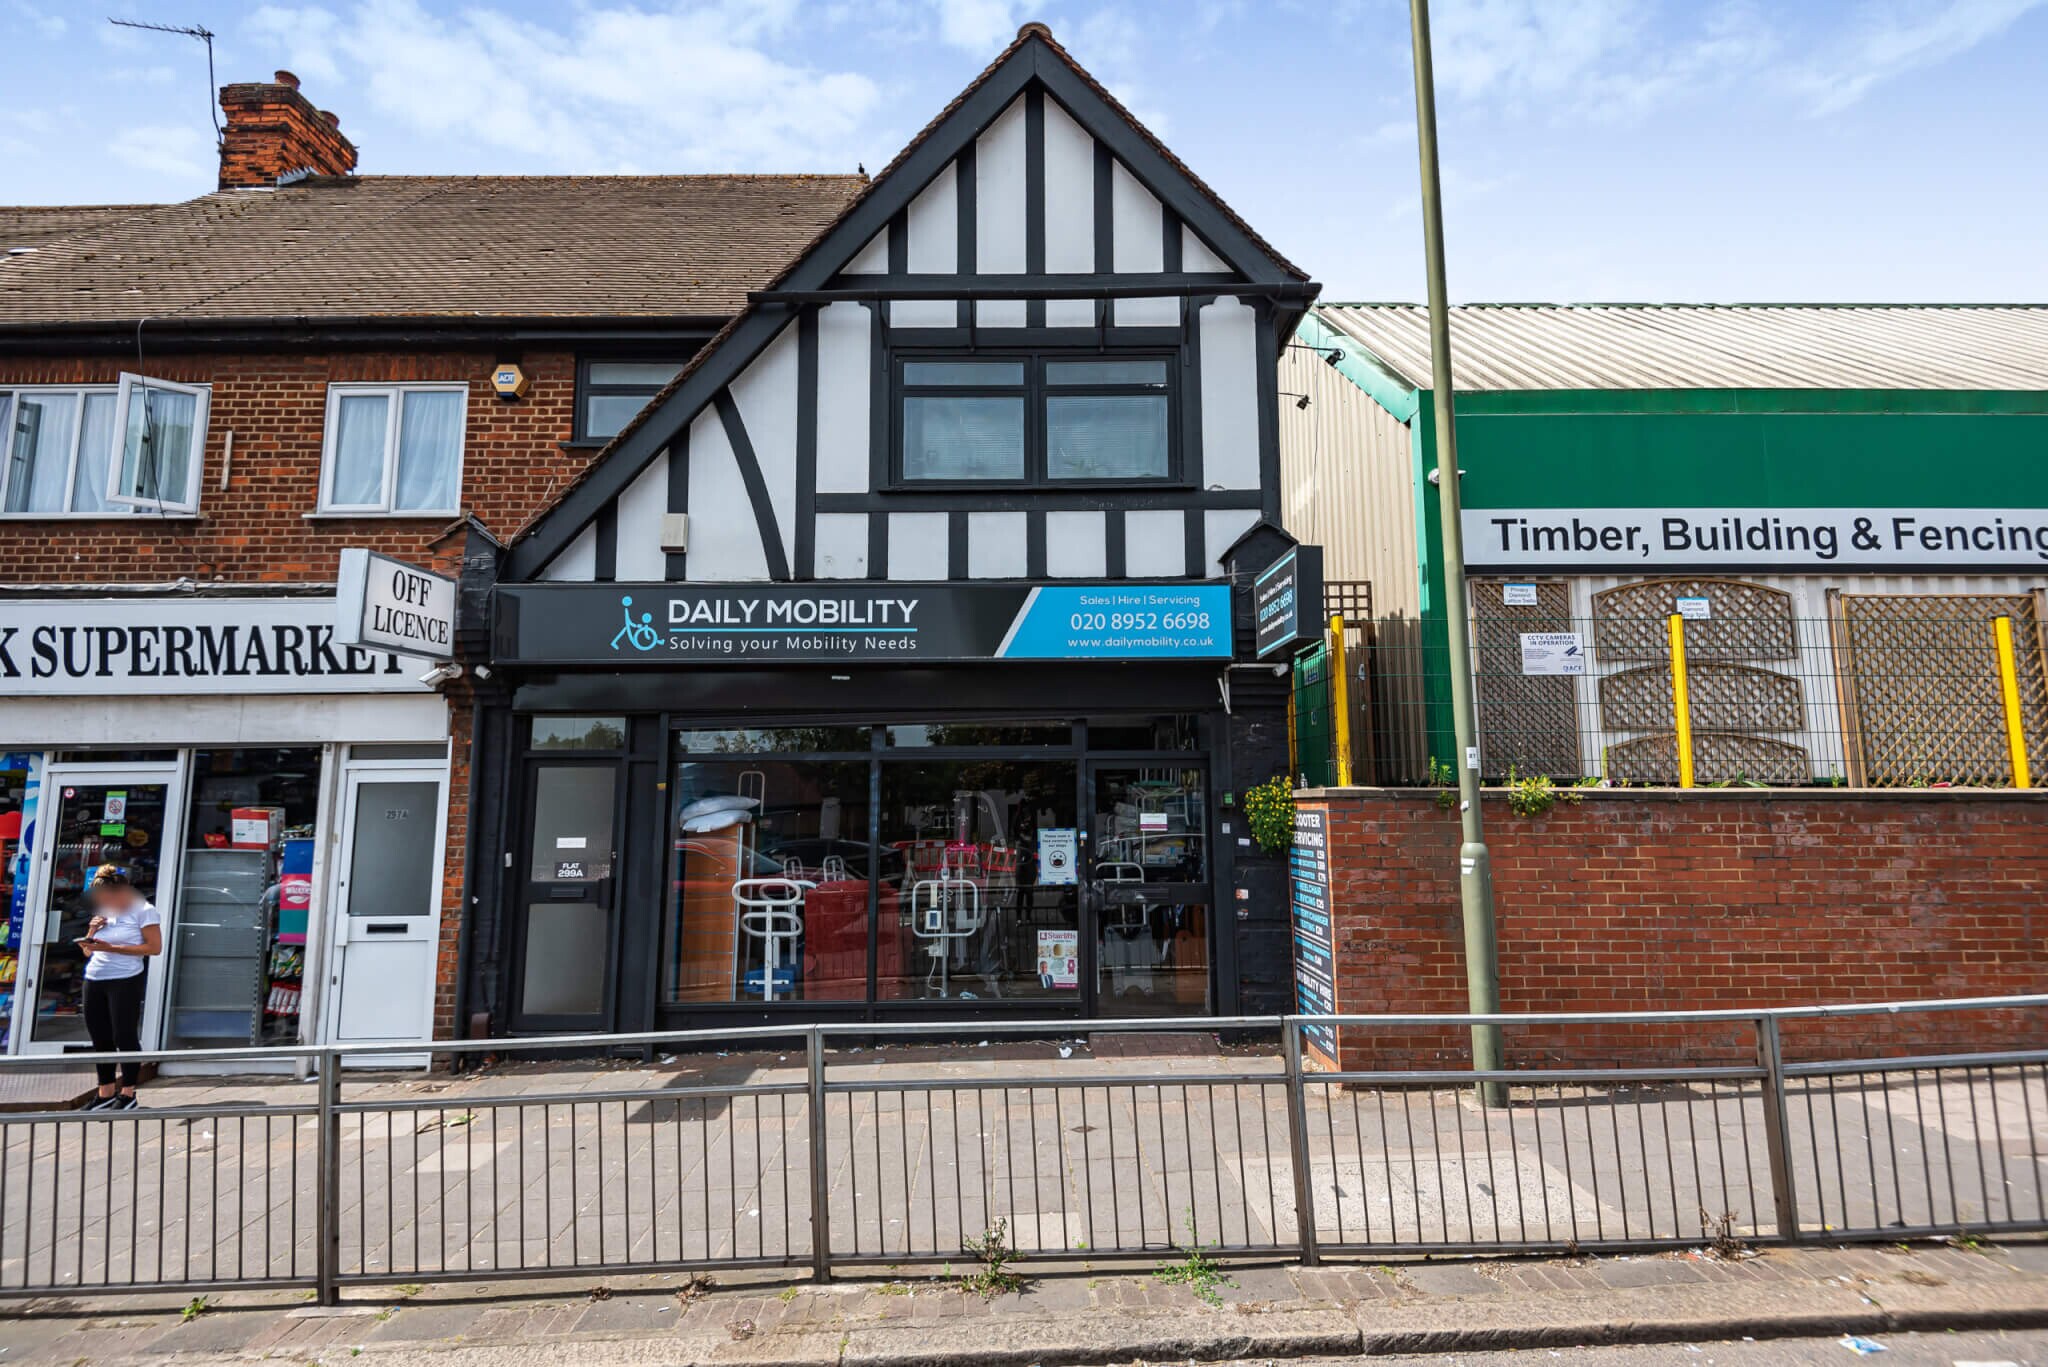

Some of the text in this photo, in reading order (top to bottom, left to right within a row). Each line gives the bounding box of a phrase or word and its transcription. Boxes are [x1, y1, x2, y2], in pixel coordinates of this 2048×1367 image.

[499, 374, 515, 382] ADT
[1491, 518, 1650, 557] Timber,
[1662, 517, 1838, 559] Building
[1851, 517, 1882, 550] &
[393, 570, 431, 607] OFF
[1080, 594, 1200, 608] Sales Hire Servicing
[668, 599, 919, 624] DAILY MOBILITY
[373, 604, 449, 645] LICENCE
[1070, 612, 1210, 630] 020 8952 6698
[670, 636, 917, 654] Solving your Mobility Needs
[1067, 635, 1214, 649] www.dailymobility.co.uk
[1295, 813, 1321, 828] COOTER
[1294, 831, 1324, 847] ERVICING
[558, 869, 583, 878] 299A
